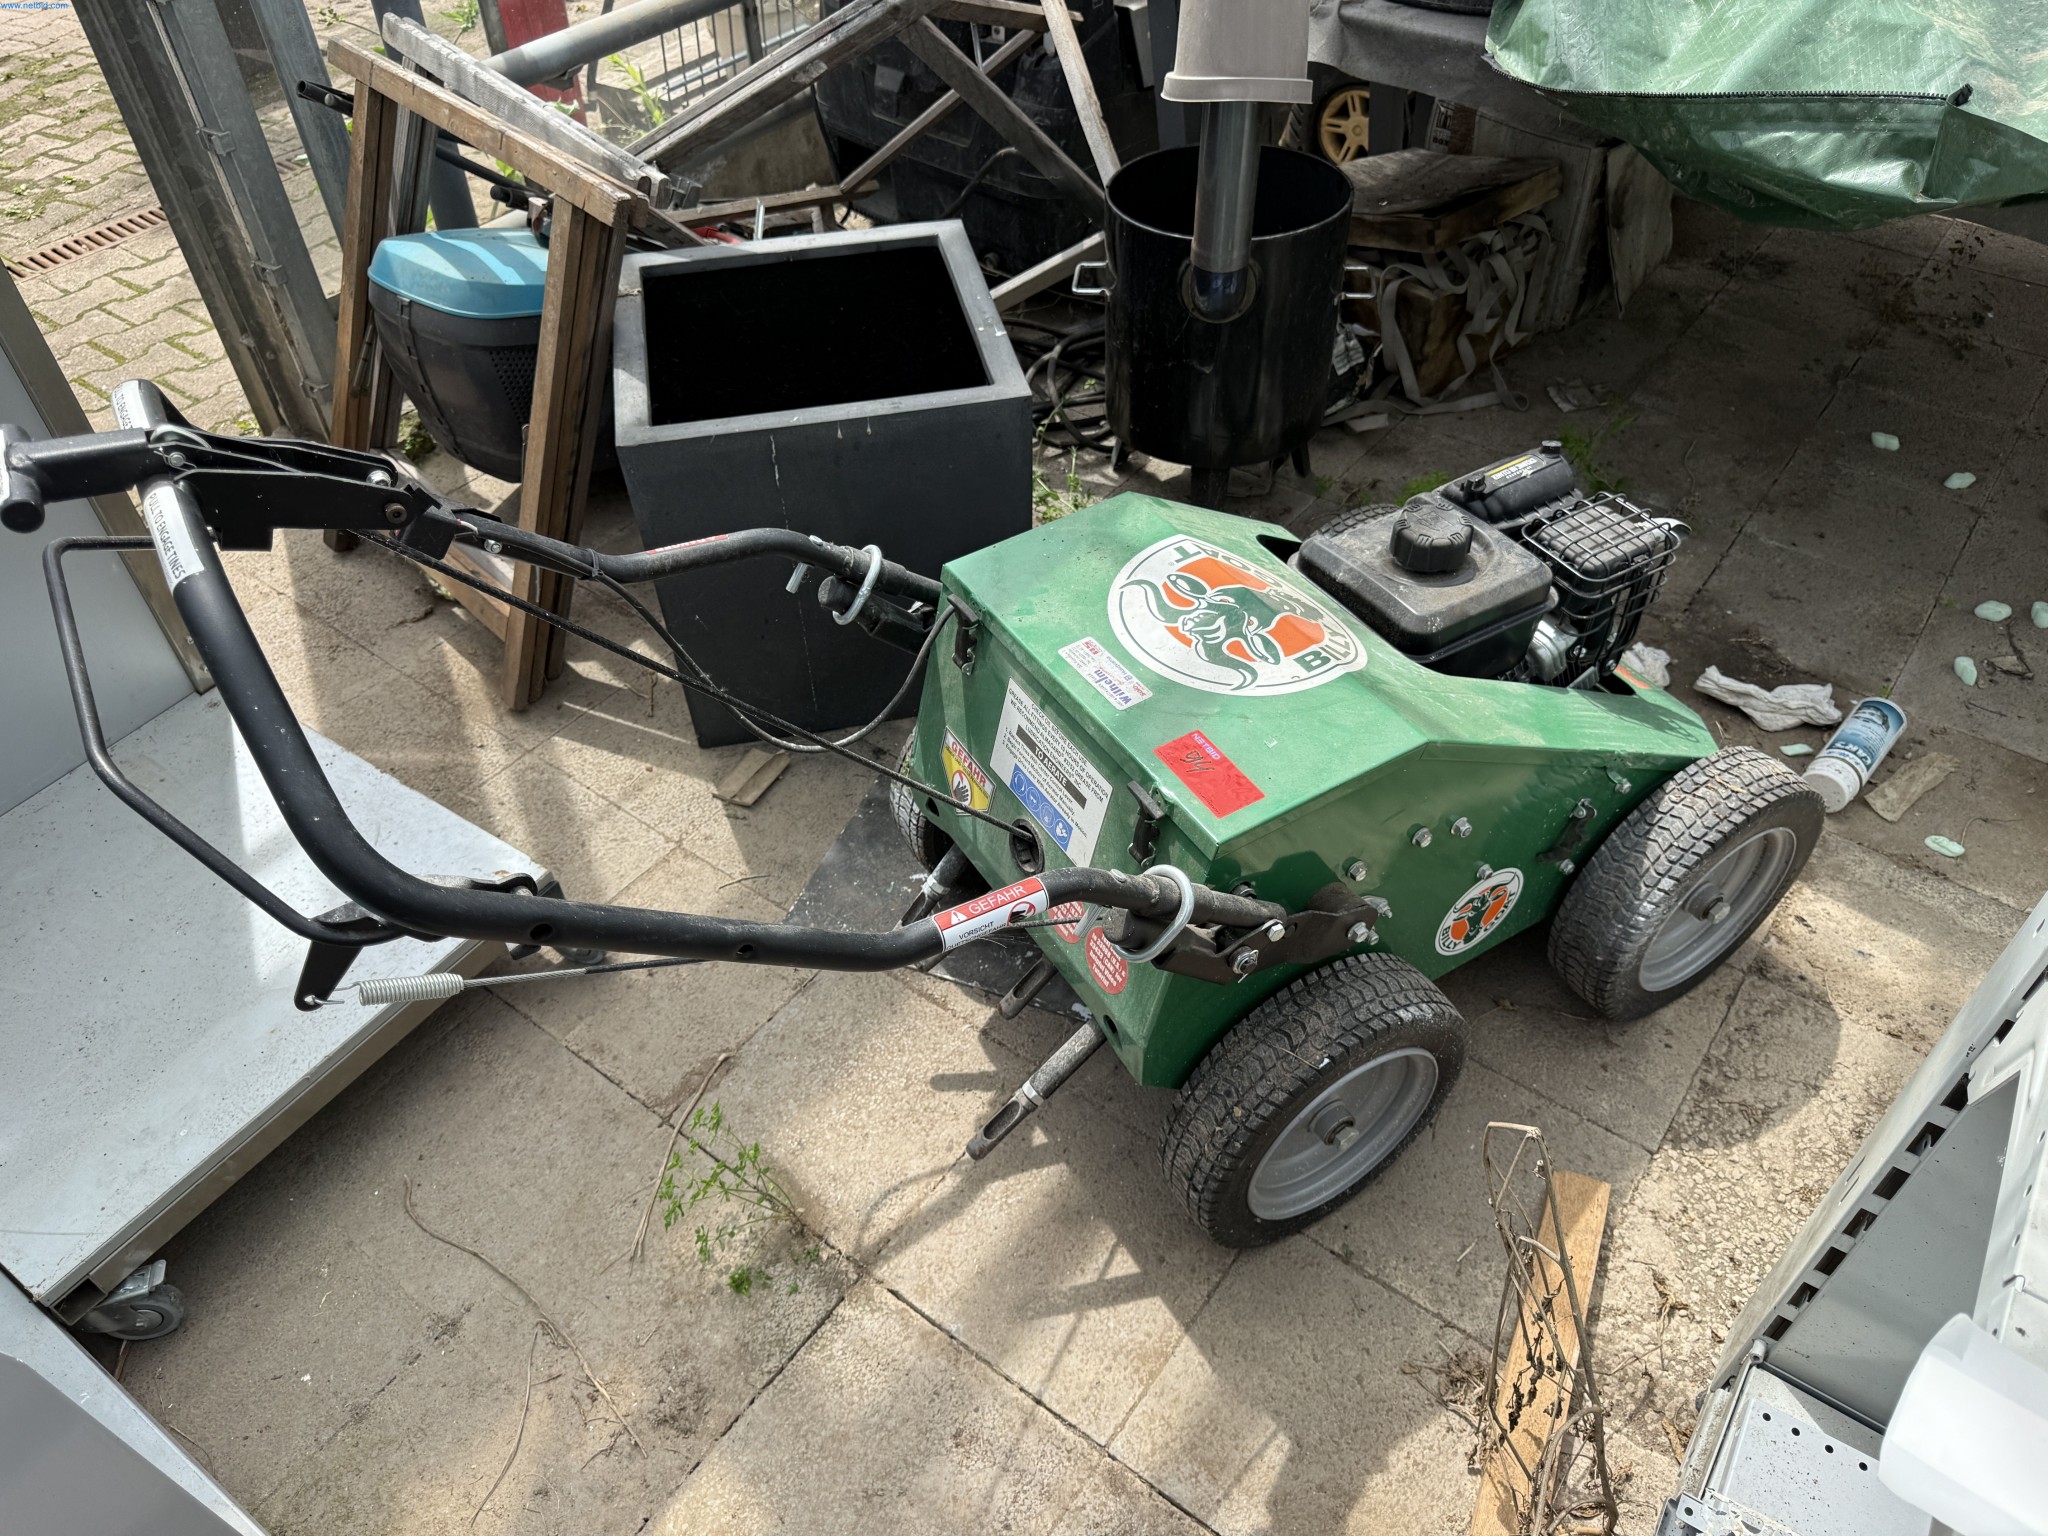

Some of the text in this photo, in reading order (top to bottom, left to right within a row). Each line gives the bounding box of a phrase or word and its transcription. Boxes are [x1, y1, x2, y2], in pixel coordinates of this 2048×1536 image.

[149, 492, 186, 580] PULL TO ENGAGE TINES
[1293, 623, 1351, 673] BILLY
[1094, 669, 1132, 705] Wilhelm
[1192, 732, 1221, 760] NETBID
[951, 741, 987, 788] GEFAHR
[1034, 746, 1067, 786] TO AERATE
[1085, 771, 1108, 798] OPERATION
[968, 885, 1027, 914] GEFAHR
[958, 921, 994, 940] VORSICHT
[1441, 924, 1462, 950] BILLY
